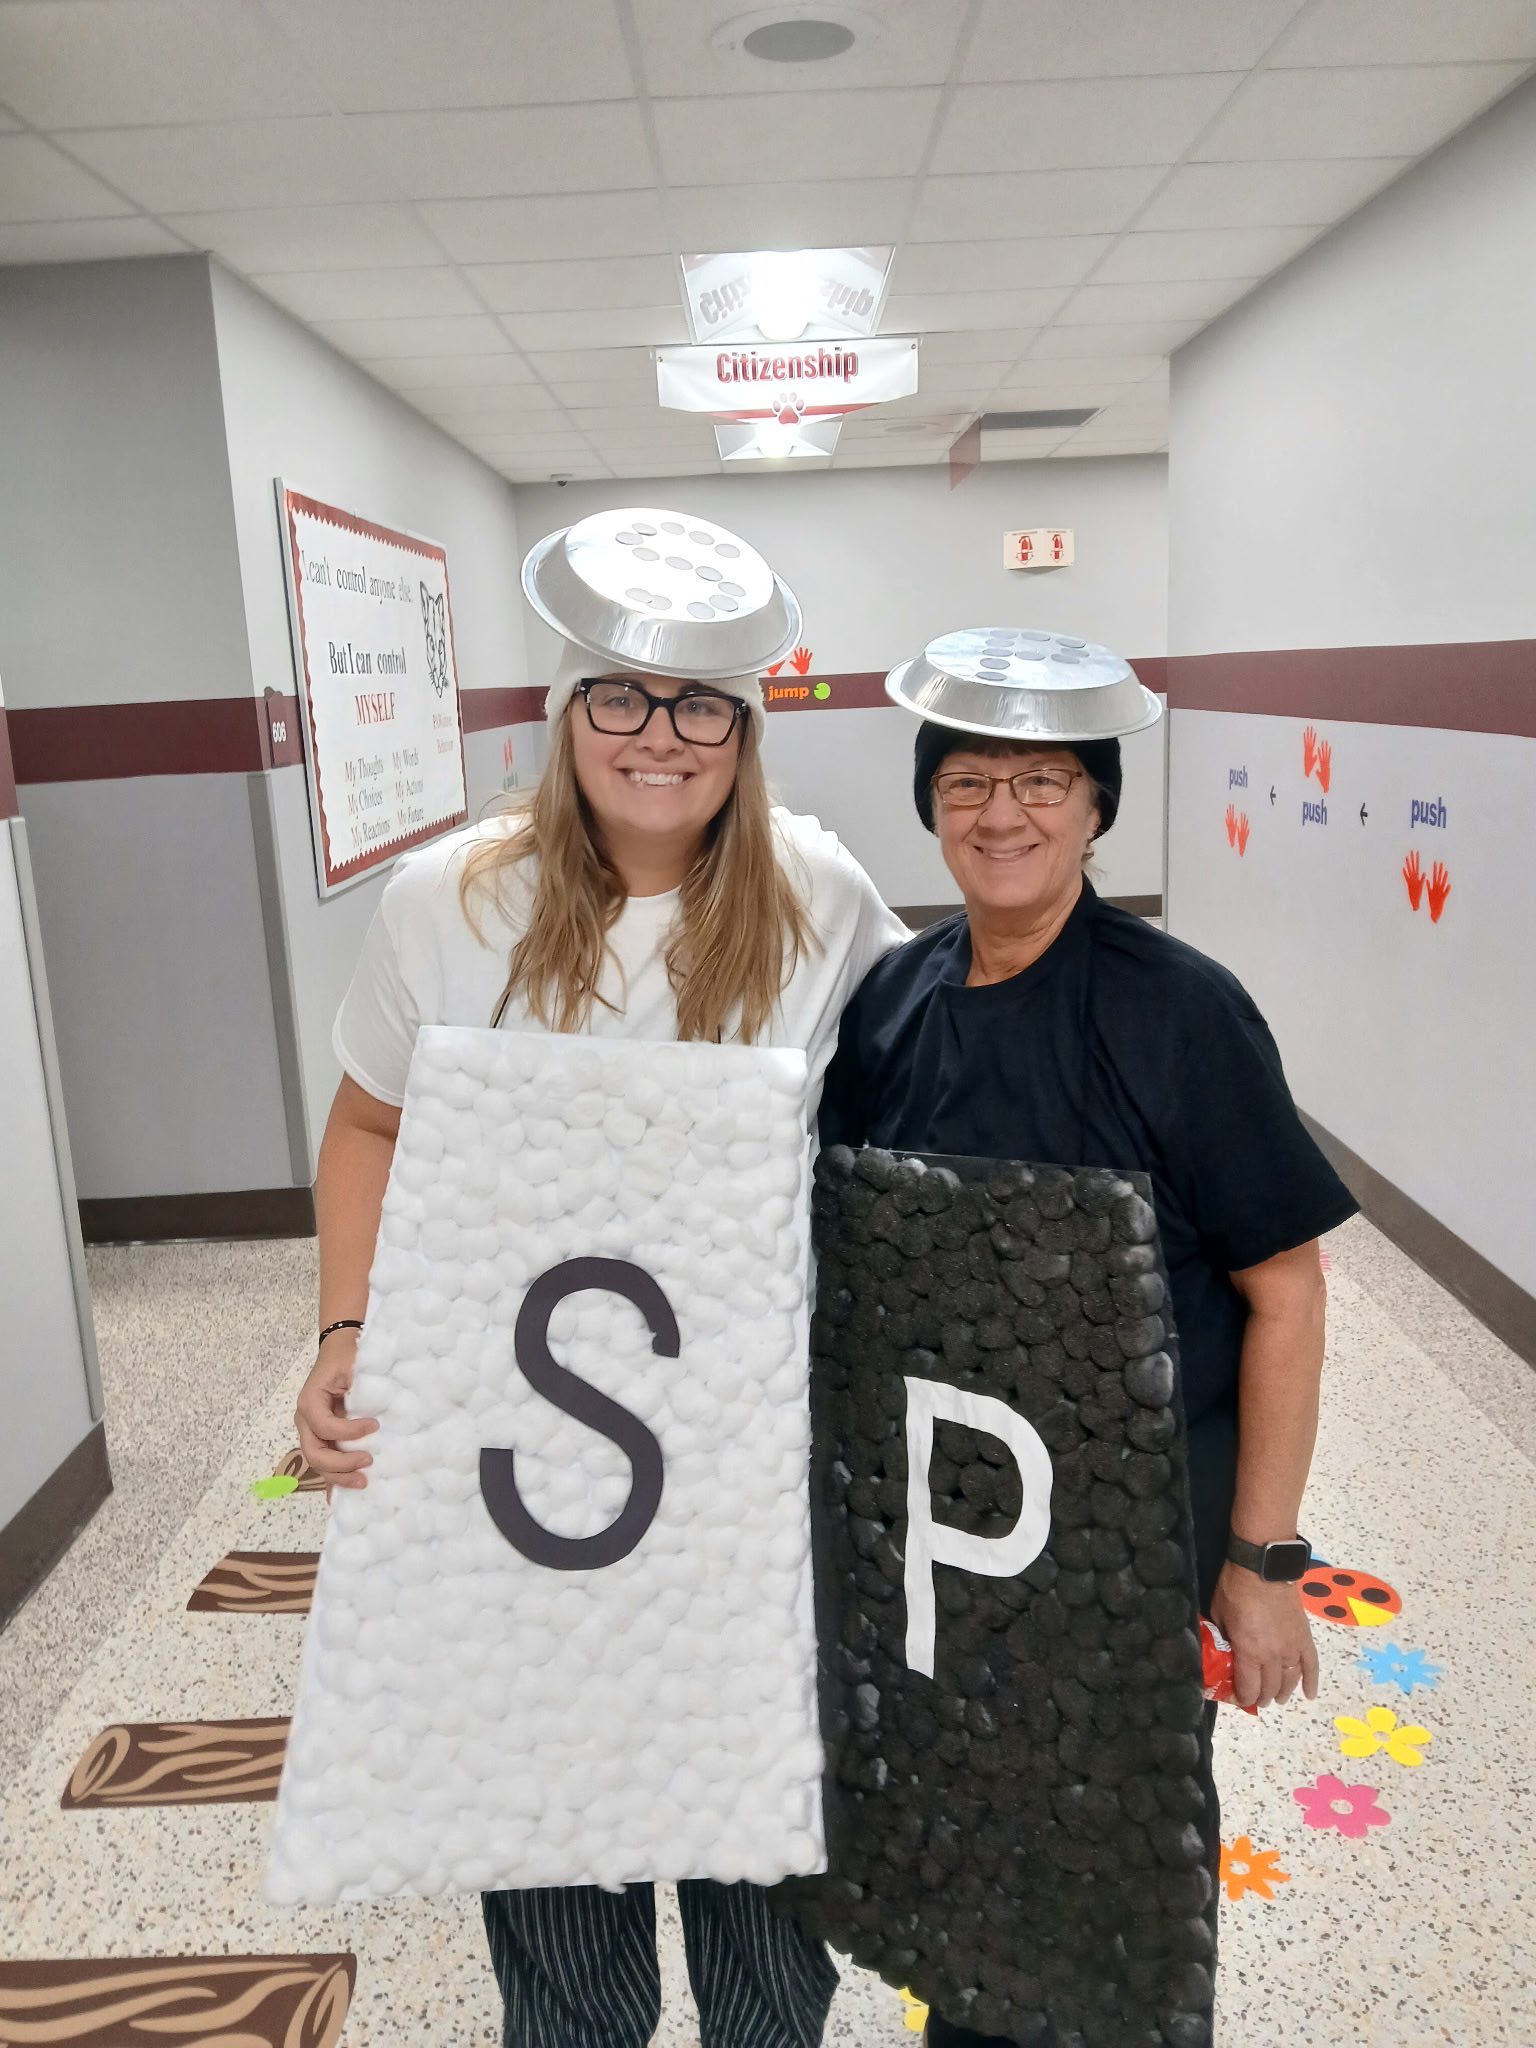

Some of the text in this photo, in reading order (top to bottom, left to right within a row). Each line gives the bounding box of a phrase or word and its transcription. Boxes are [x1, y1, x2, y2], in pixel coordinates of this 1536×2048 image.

[716, 346, 859, 384] Citizenship
[309, 556, 332, 586] can't
[336, 566, 367, 594] control
[369, 576, 396, 605] anyone
[328, 641, 407, 674] But I can control
[355, 692, 396, 726] MYSELF
[768, 685, 810, 701] jump
[272, 721, 287, 743] 606
[344, 761, 357, 787] My
[1229, 765, 1248, 790] push
[347, 794, 360, 819] My
[358, 786, 383, 811] Choices
[1302, 799, 1328, 826] push
[1410, 797, 1447, 829] push
[362, 817, 391, 842] Reactions
[479, 1256, 680, 1571] S
[903, 1376, 1053, 1679] P
